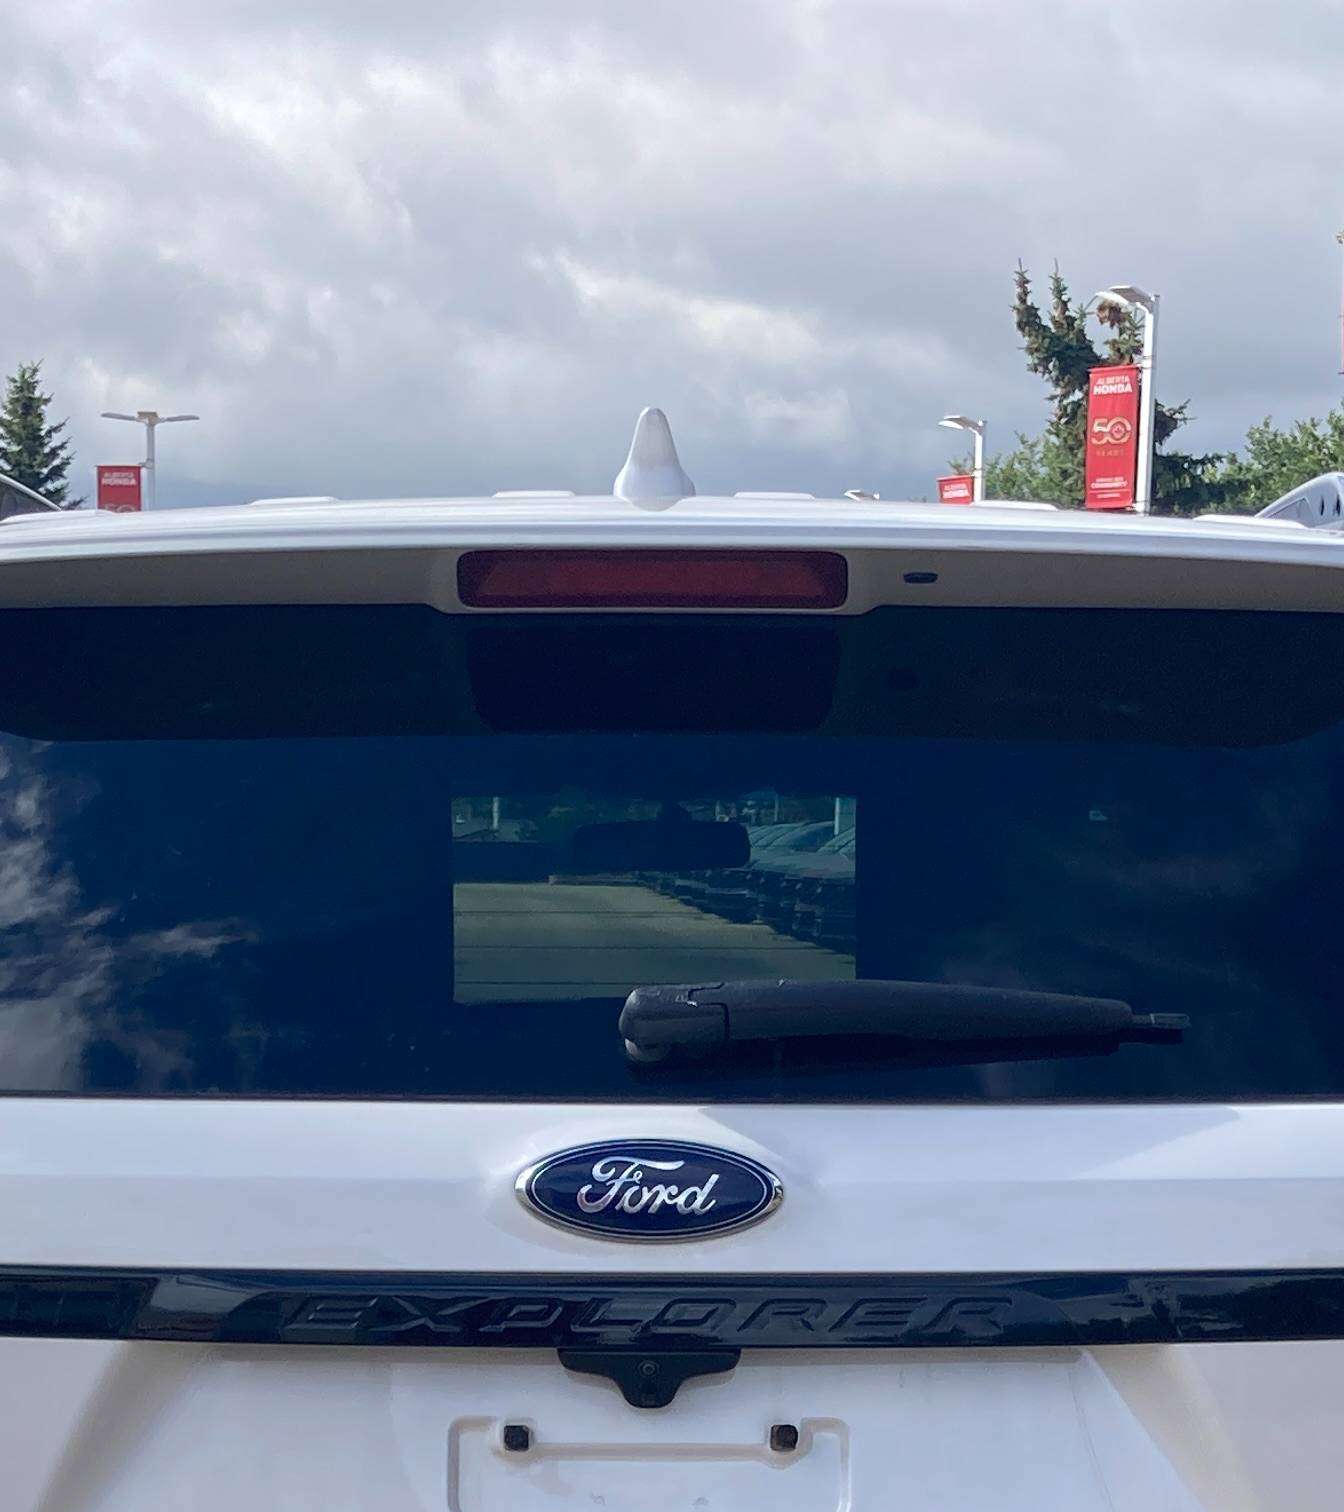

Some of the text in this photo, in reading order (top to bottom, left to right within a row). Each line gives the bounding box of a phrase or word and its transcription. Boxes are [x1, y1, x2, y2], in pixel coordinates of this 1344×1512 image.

[1091, 417, 1132, 445] 50
[577, 1156, 720, 1214] Ford
[280, 1296, 1014, 1333] EXPLORER
